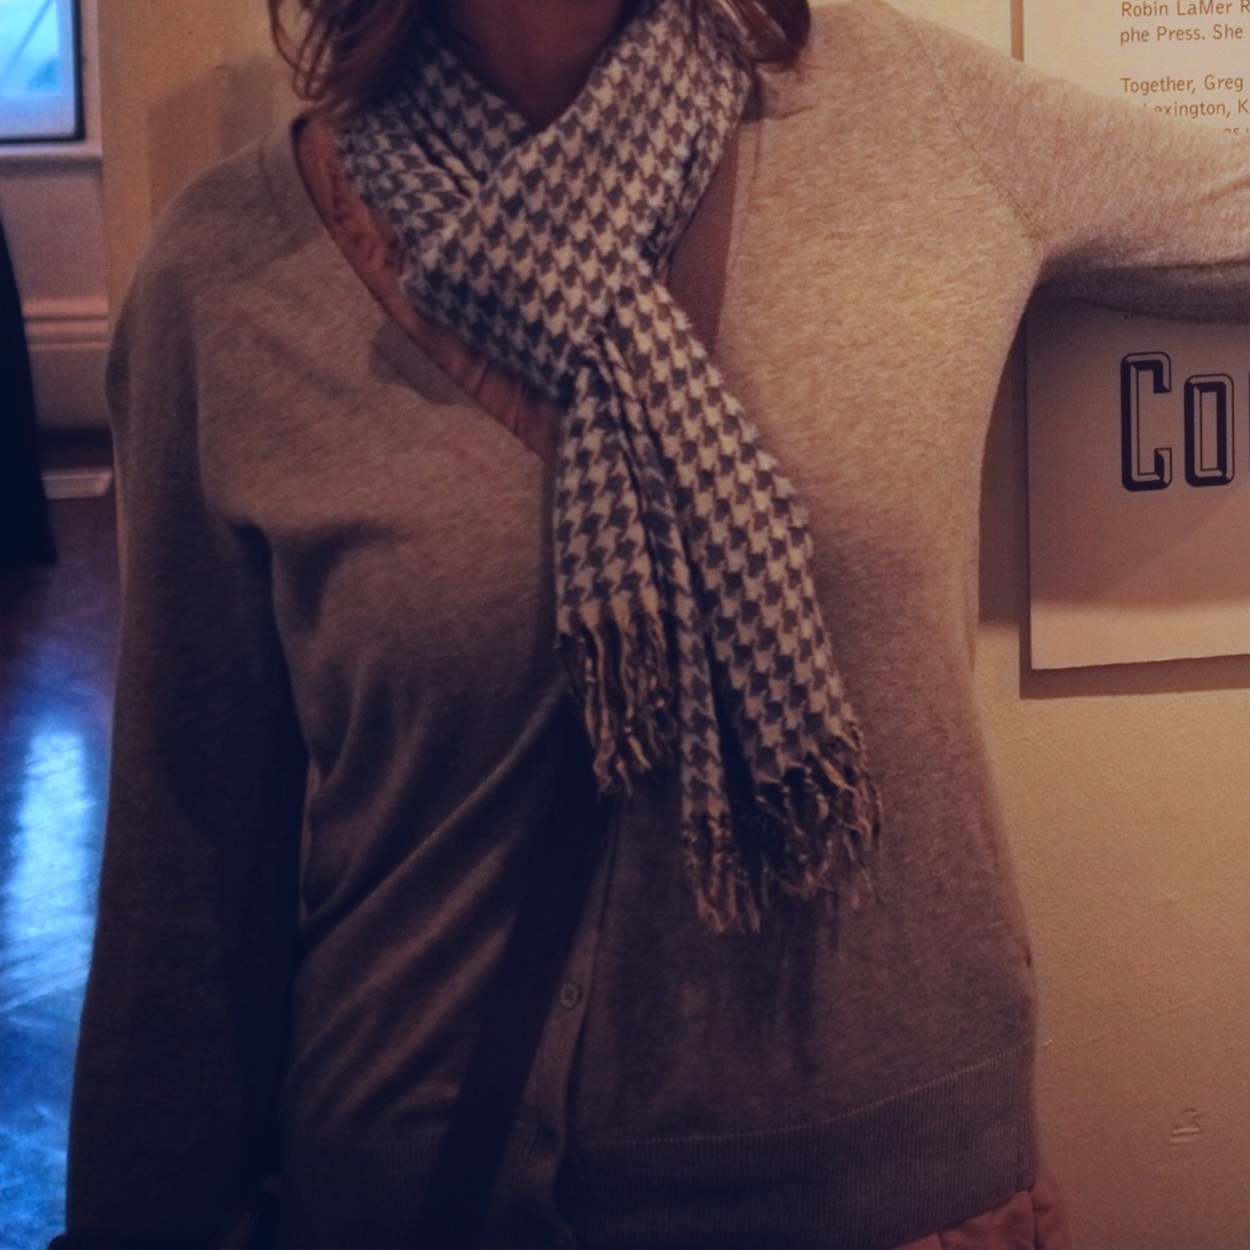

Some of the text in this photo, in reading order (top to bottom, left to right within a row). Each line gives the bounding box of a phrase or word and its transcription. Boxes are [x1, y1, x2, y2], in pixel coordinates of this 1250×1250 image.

[1121, 0, 1168, 17] Robin
[1176, 0, 1233, 15] LaMer
[1156, 25, 1205, 41] Press.
[1119, 75, 1196, 95] Together,
[1203, 74, 1243, 92] Greg
